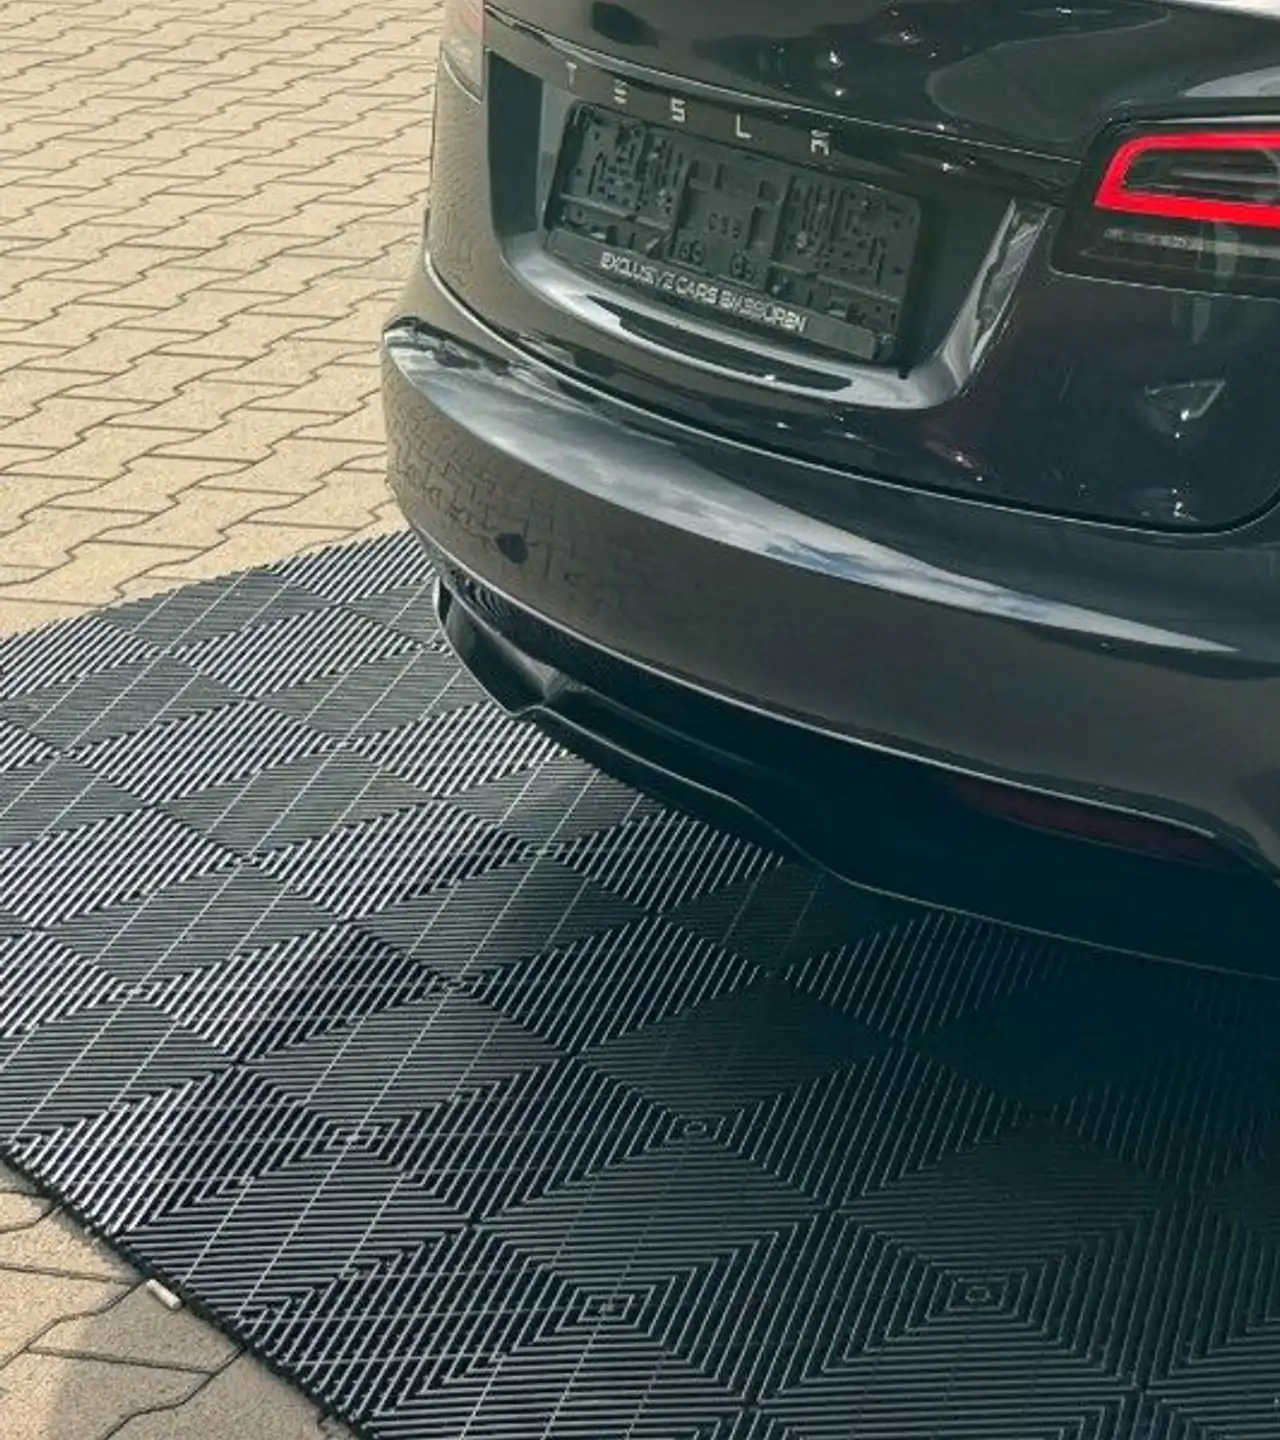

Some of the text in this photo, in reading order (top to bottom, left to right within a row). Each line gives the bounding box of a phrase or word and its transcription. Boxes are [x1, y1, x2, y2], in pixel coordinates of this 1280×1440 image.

[565, 60, 830, 157] TESLA
[600, 251, 675, 291] EXCLUSIVE
[675, 275, 719, 305] CARS
